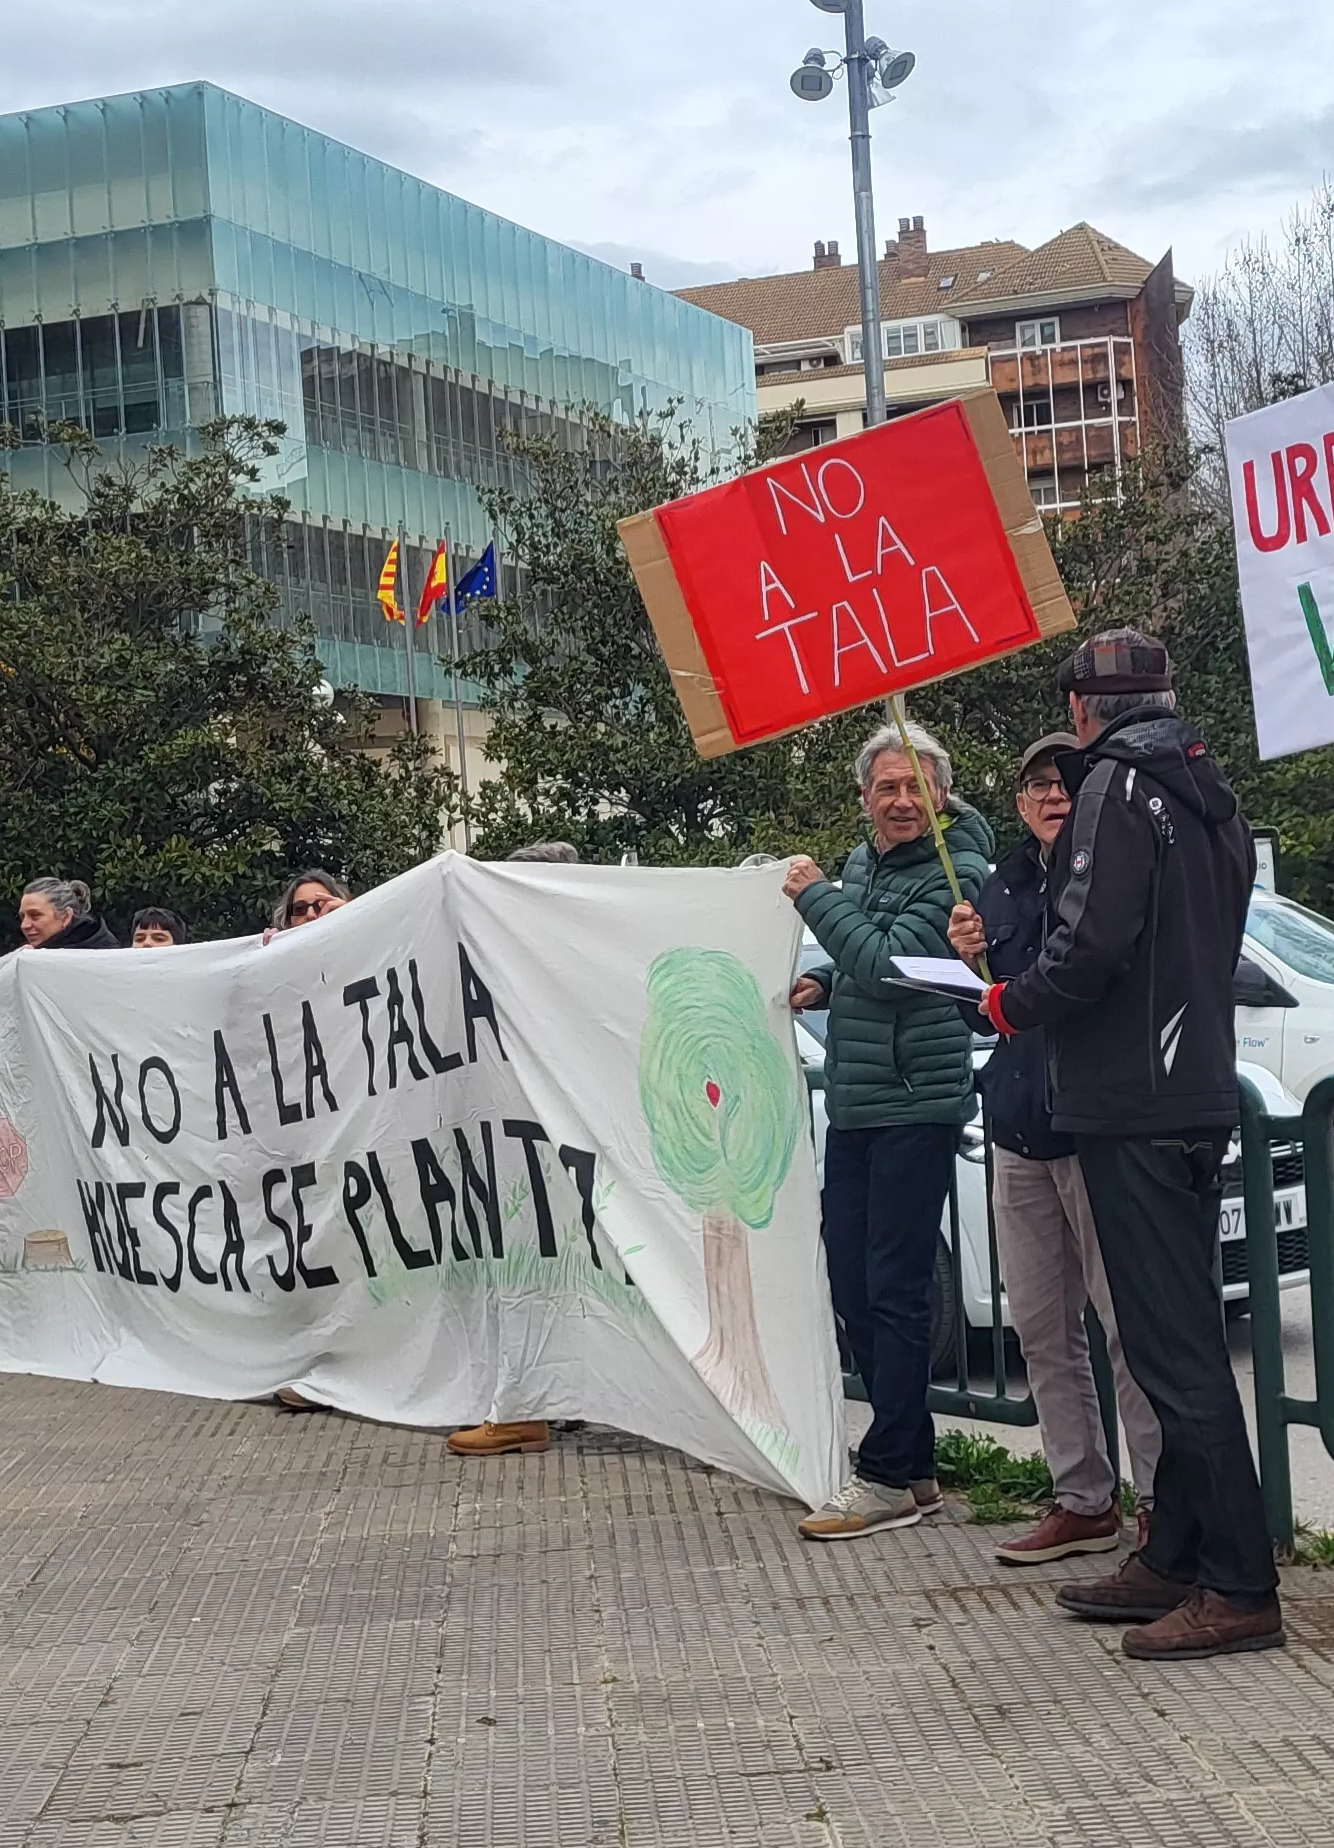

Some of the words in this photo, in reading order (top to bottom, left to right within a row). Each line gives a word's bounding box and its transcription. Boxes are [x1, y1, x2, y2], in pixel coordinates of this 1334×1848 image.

[767, 458, 865, 536] NO
[755, 566, 980, 694] TALA
[759, 560, 796, 621] A
[834, 516, 915, 583] LA
[88, 1053, 181, 1148] NO
[214, 1029, 252, 1140] A
[262, 1000, 339, 1126] LA
[343, 942, 508, 1096] TALA
[77, 1179, 251, 1292] HUESCA
[262, 1161, 340, 1292] SE
